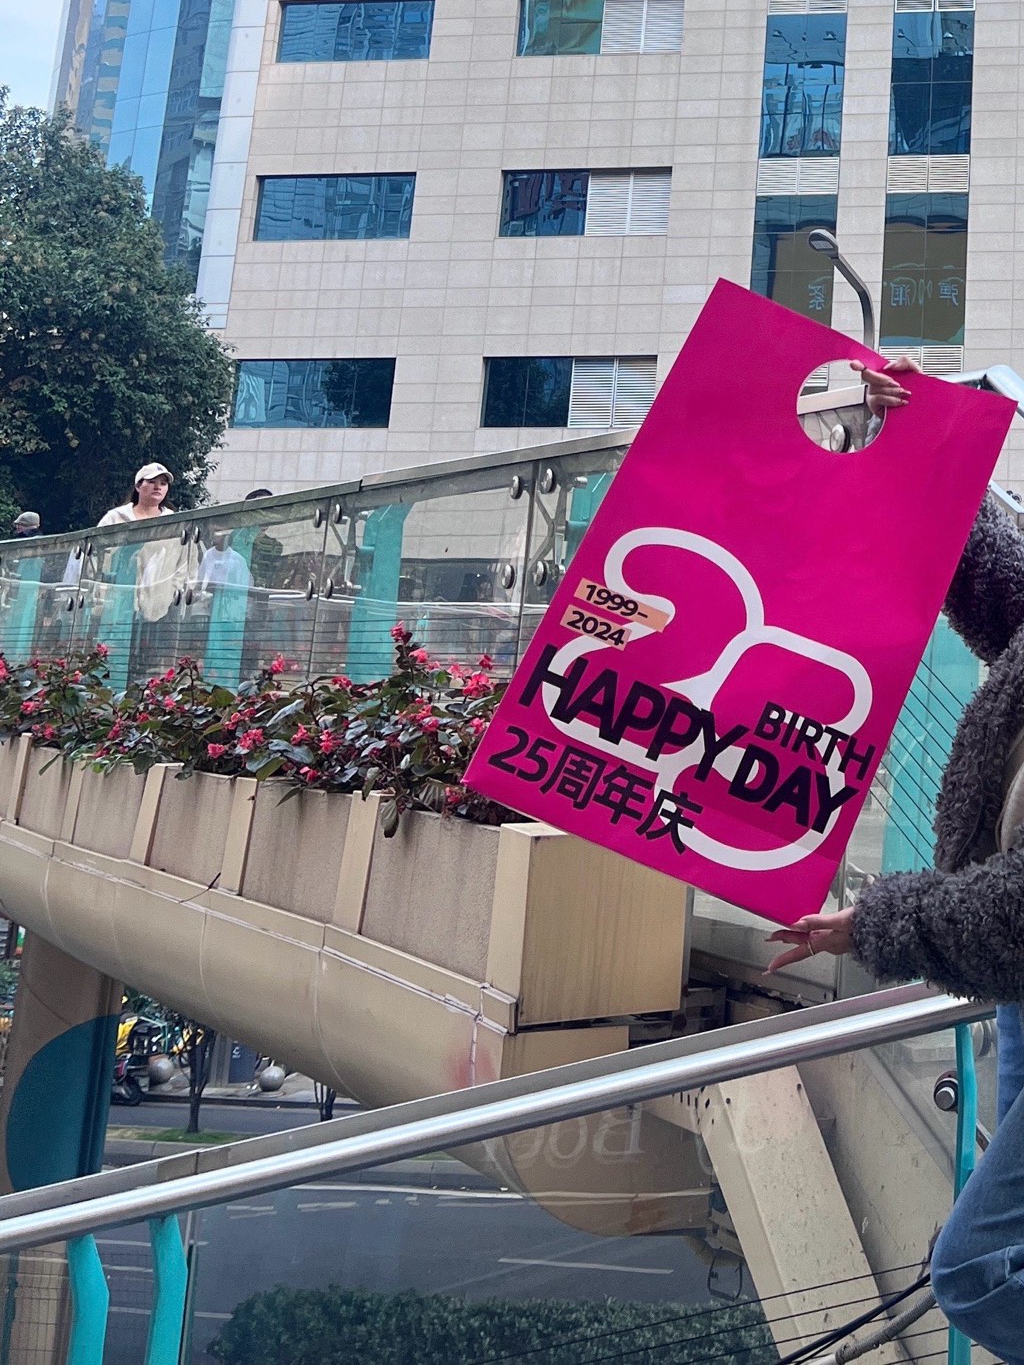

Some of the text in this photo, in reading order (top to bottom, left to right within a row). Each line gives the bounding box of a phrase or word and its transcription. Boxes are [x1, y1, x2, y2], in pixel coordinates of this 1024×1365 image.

[566, 609, 626, 647] 2024
[487, 726, 704, 856] 25周年庆
[518, 643, 860, 835] HAPPY DAY
[753, 700, 876, 782] BIRTH
